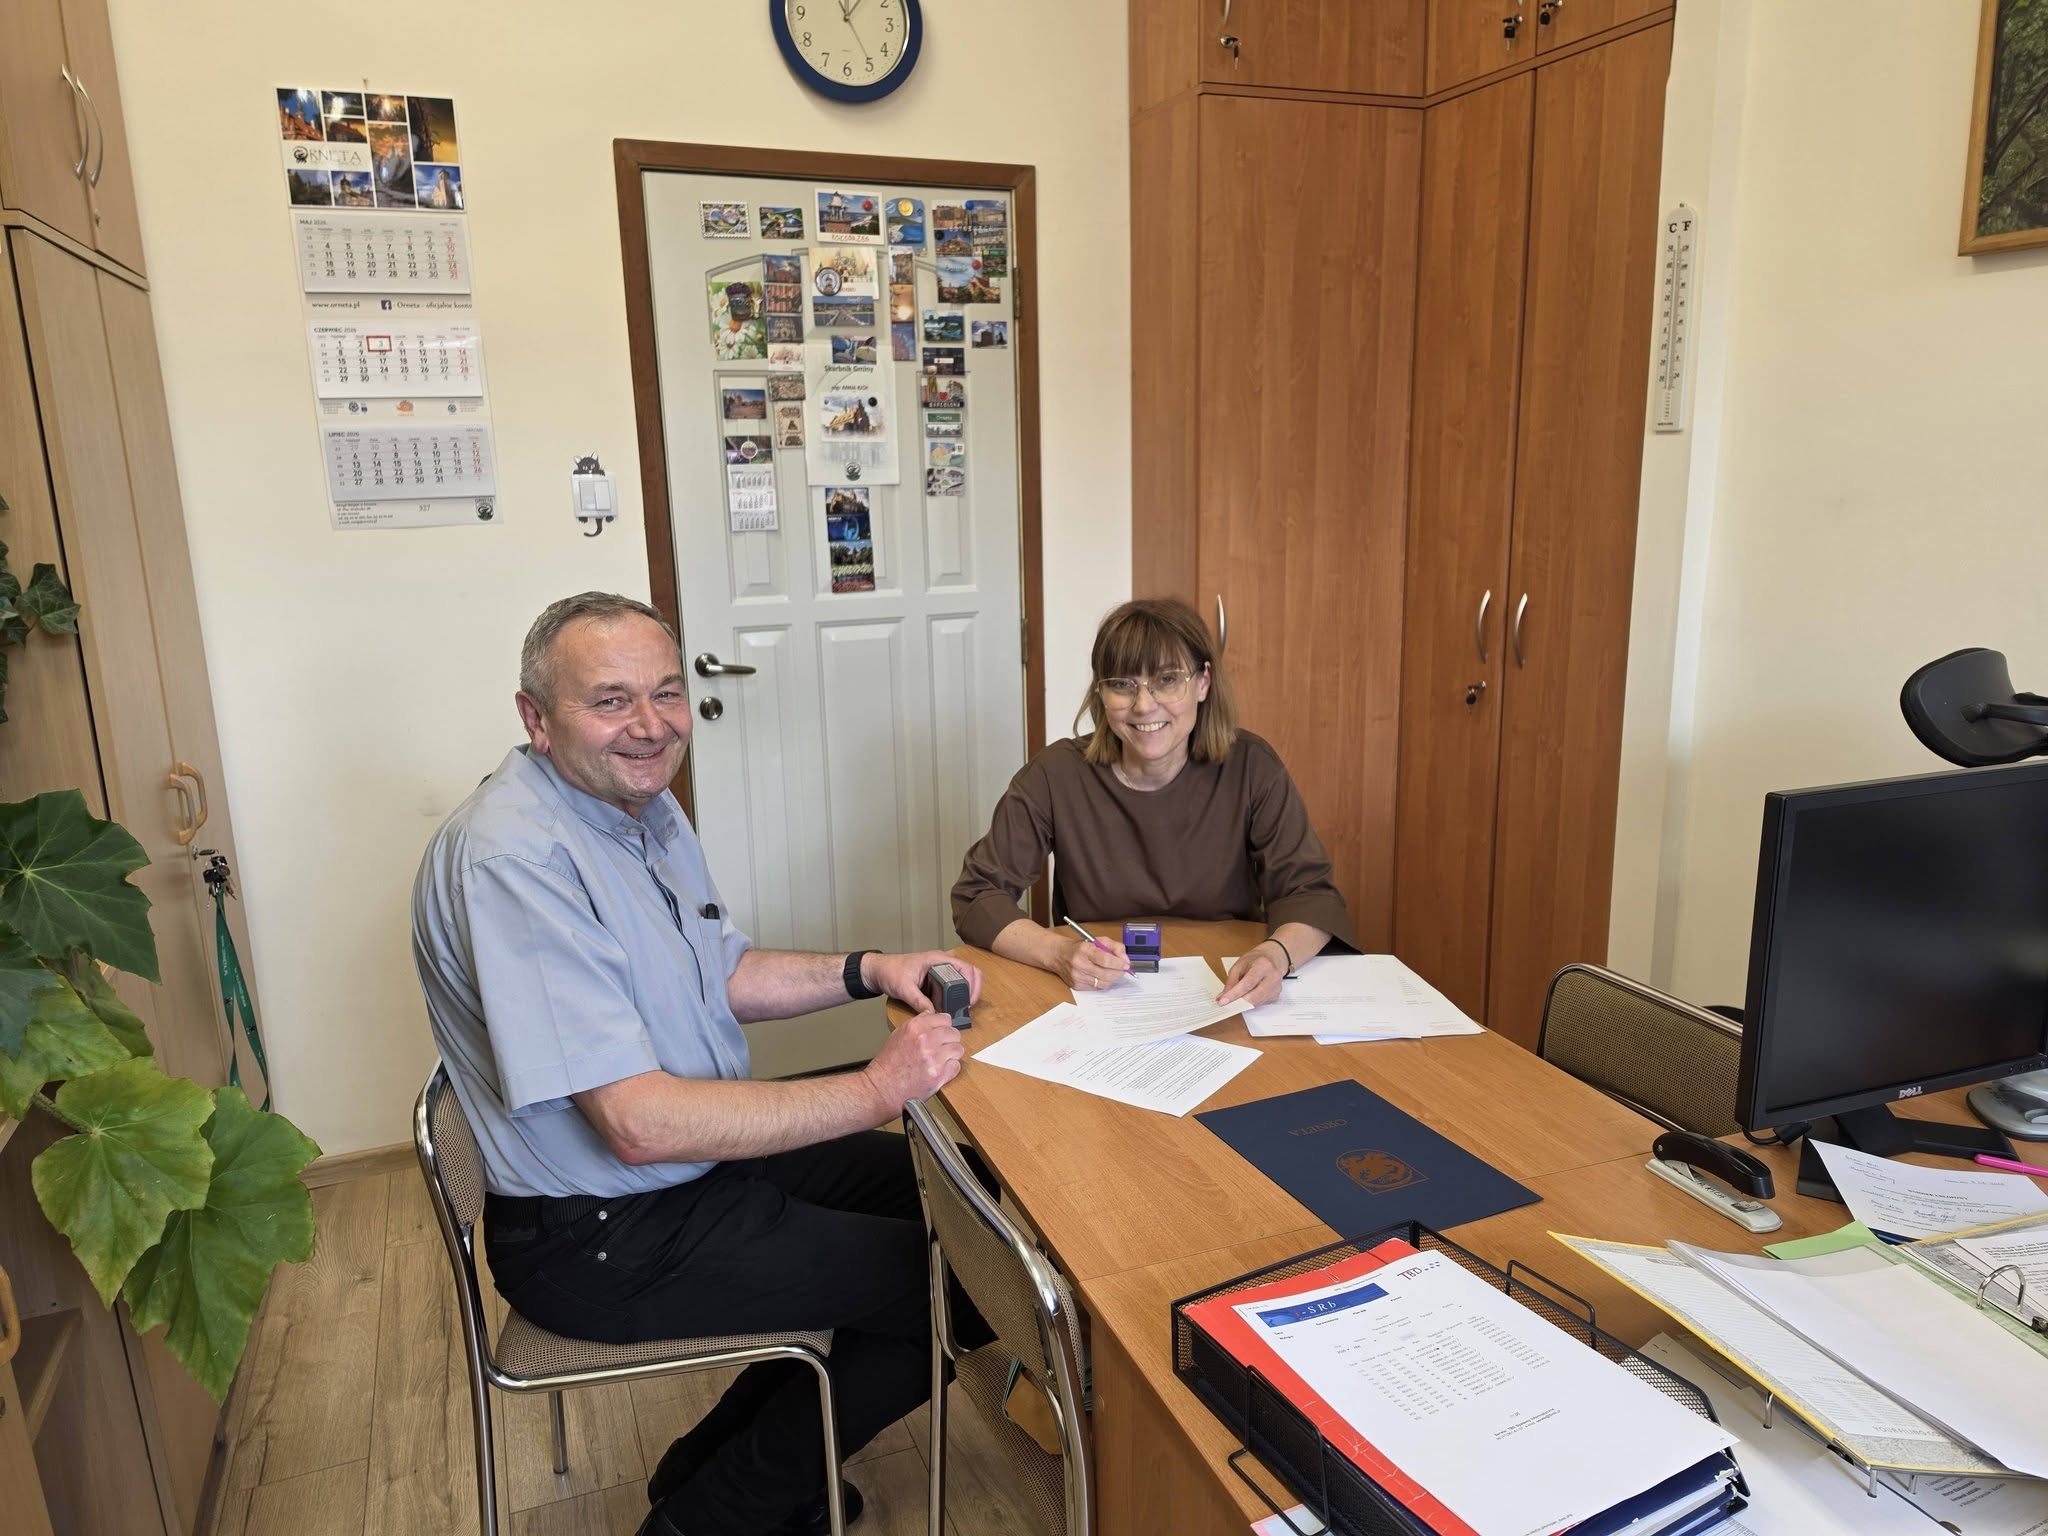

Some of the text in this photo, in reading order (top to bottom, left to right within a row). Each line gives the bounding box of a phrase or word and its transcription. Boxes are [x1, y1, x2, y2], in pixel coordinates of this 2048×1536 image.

[796, 5, 806, 20] 9
[885, 18, 894, 32] 3
[803, 32, 812, 47] 8
[880, 42, 888, 57] 4
[821, 52, 830, 67] 7
[865, 57, 874, 72] 5
[843, 62, 852, 76] 6
[1668, 220, 1691, 233] C F
[853, 365, 874, 373] Gminy
[1898, 1086, 1923, 1099] DELL
[1397, 1266, 1423, 1282] TBD
